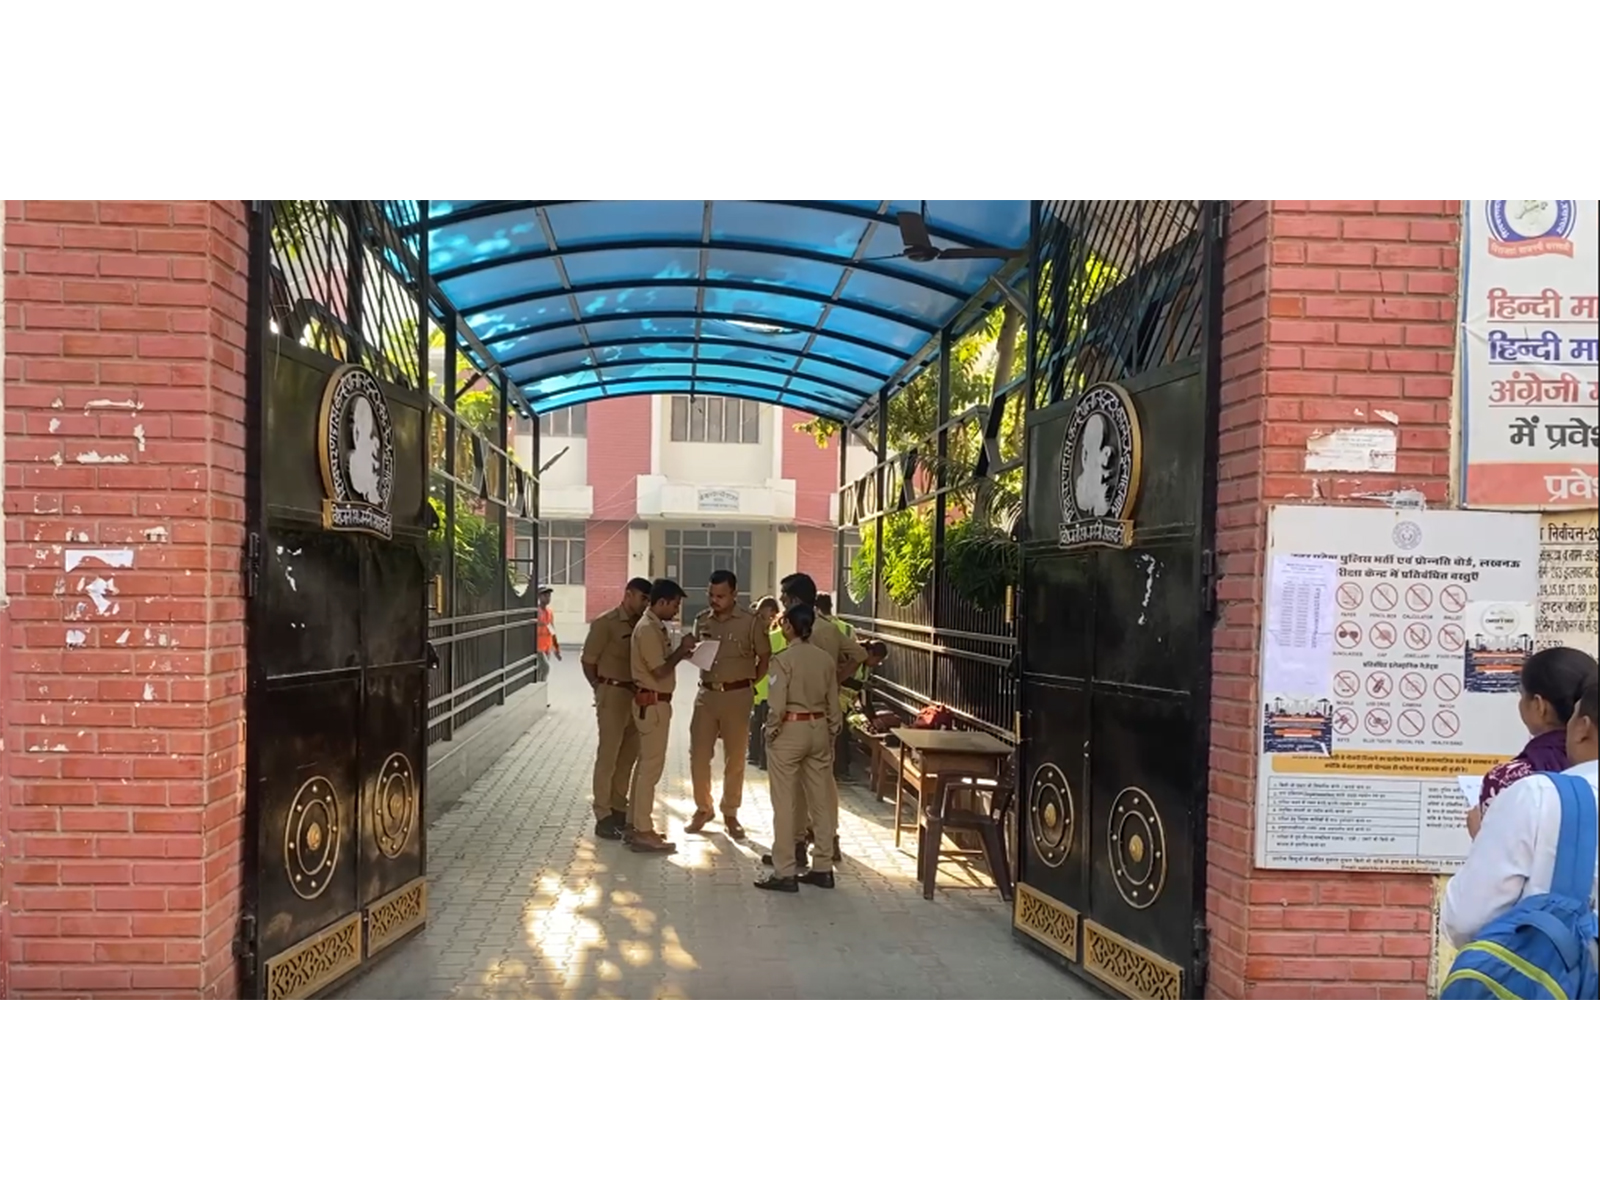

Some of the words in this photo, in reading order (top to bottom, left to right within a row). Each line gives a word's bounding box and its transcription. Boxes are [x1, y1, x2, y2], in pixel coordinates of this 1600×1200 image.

[1487, 288, 1562, 318] हिन्दी
[1488, 330, 1562, 361] हिन्दी
[1489, 371, 1581, 405] अंग्रेजी
[1508, 415, 1540, 447] में
[1336, 567, 1362, 578] रीक्षा
[1340, 553, 1372, 567] पुलिस
[1397, 554, 1413, 565] एवं
[1479, 559, 1521, 569] लखनऊ
